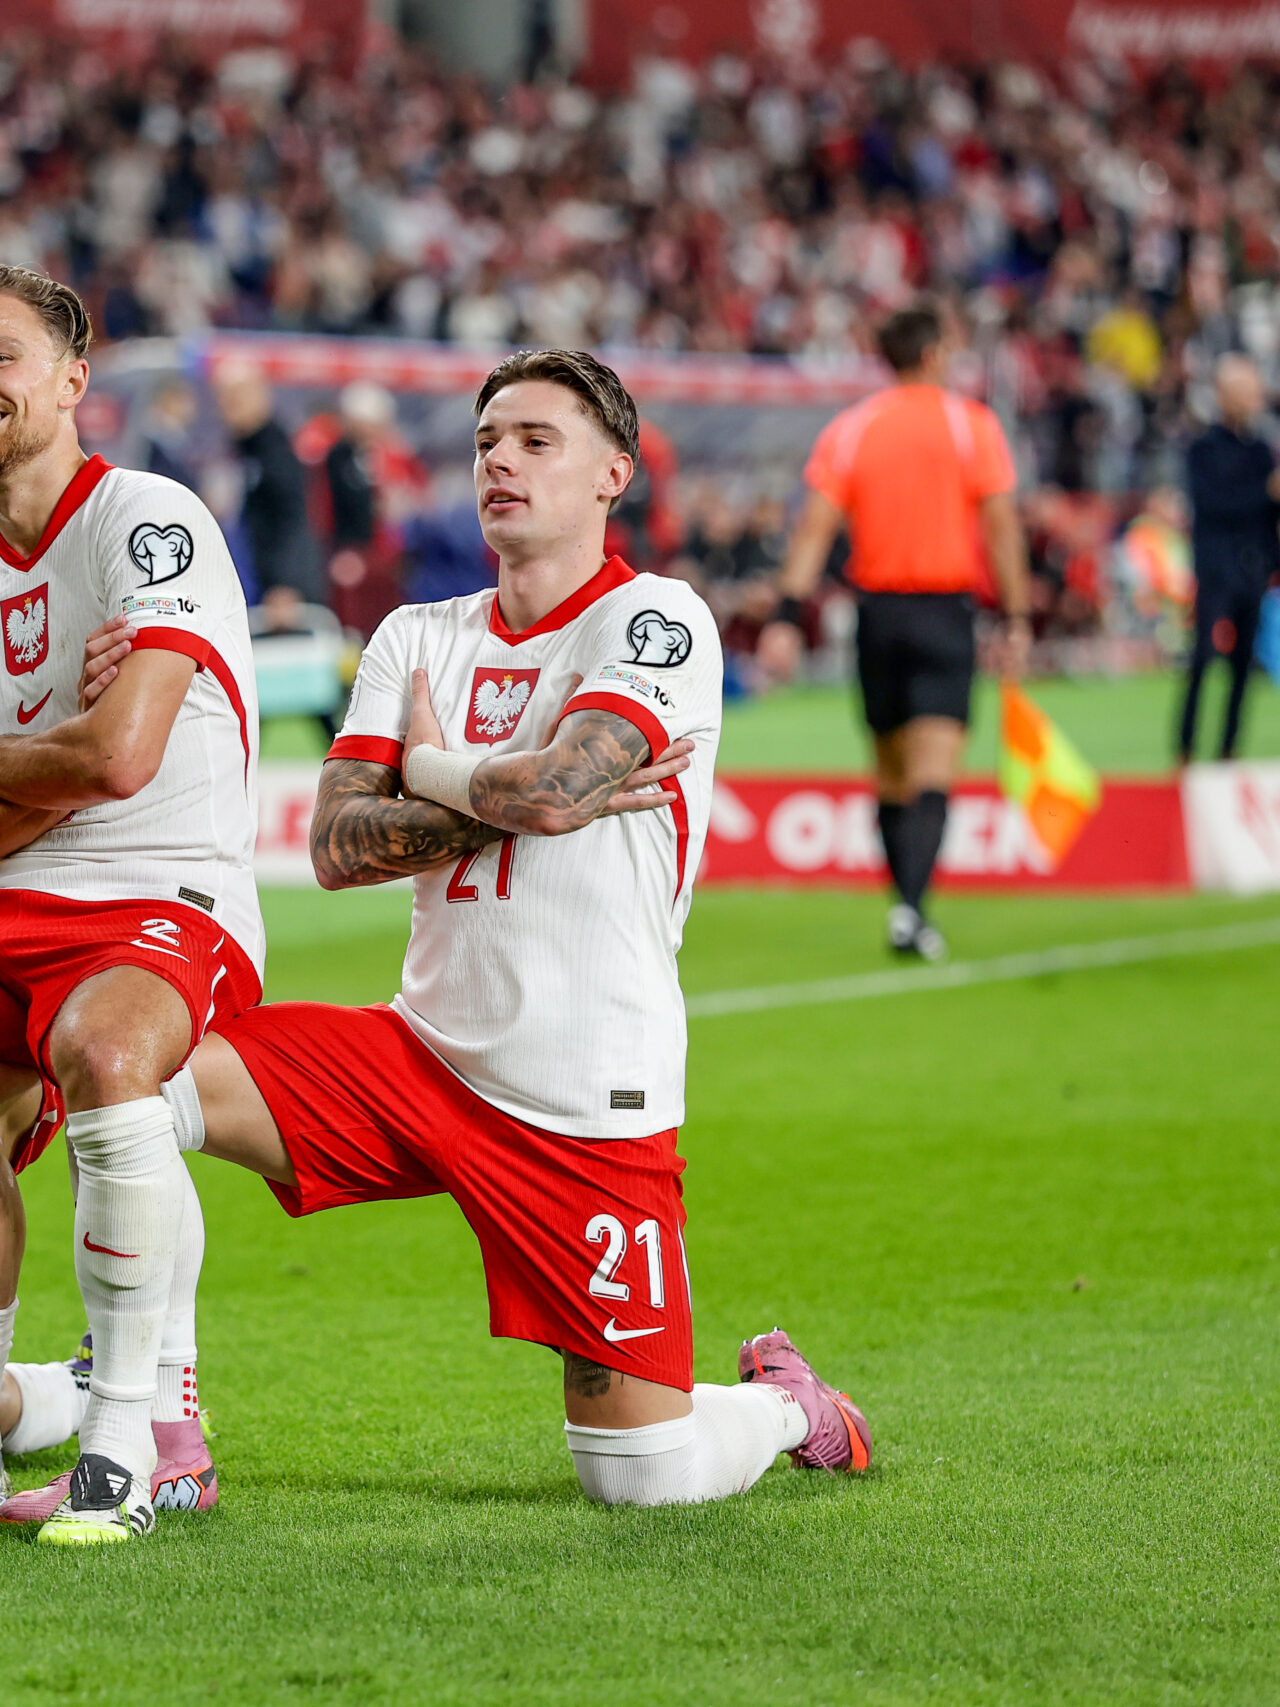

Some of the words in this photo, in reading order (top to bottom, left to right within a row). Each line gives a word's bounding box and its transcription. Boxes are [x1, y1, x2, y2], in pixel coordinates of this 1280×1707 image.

[122, 599, 177, 614] FOUNDATION
[599, 671, 654, 692] FOUNDATION
[766, 789, 1057, 874] OREN
[446, 832, 519, 904] 21
[140, 918, 182, 948] 2
[585, 1213, 666, 1308] 21
